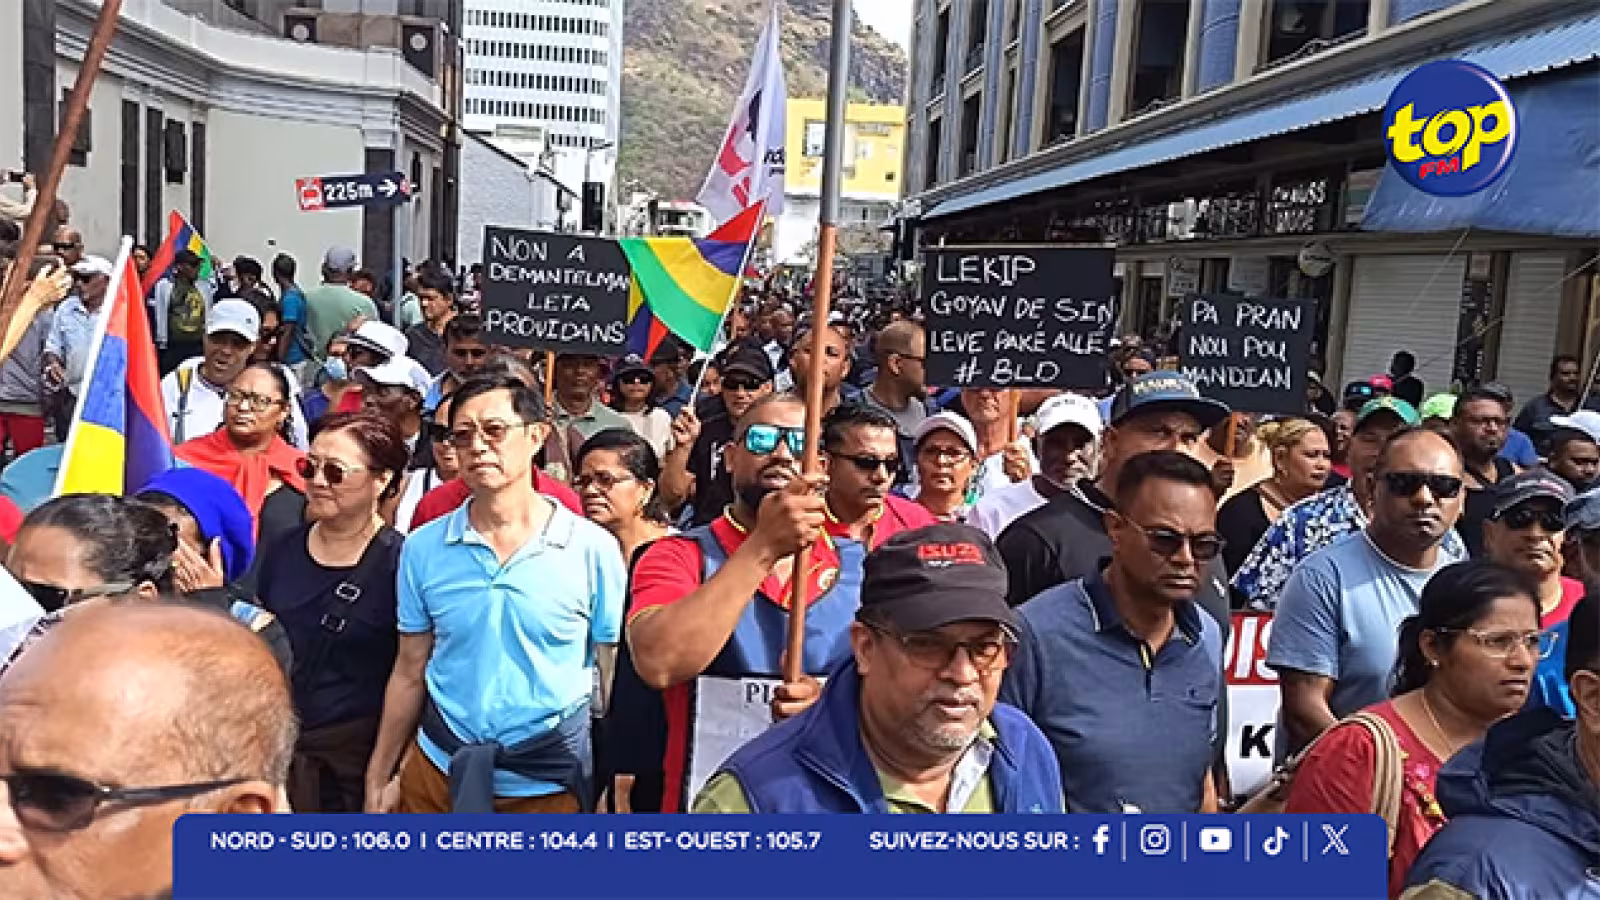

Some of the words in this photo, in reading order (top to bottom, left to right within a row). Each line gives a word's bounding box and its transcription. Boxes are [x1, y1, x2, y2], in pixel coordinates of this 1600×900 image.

[323, 181, 373, 201] 225m
[491, 234, 548, 262] NON
[566, 244, 586, 264] A
[937, 254, 1036, 287] LEKIP
[528, 292, 591, 312] LETA
[1014, 297, 1046, 319] DE
[1054, 296, 1114, 324] SIN
[1191, 300, 1219, 325] PA
[1236, 303, 1301, 330] PRAN
[485, 309, 626, 345] PROVIDANS
[930, 330, 987, 354] LEVE
[1190, 335, 1228, 357] NOU
[1182, 366, 1291, 390] MANDIAN
